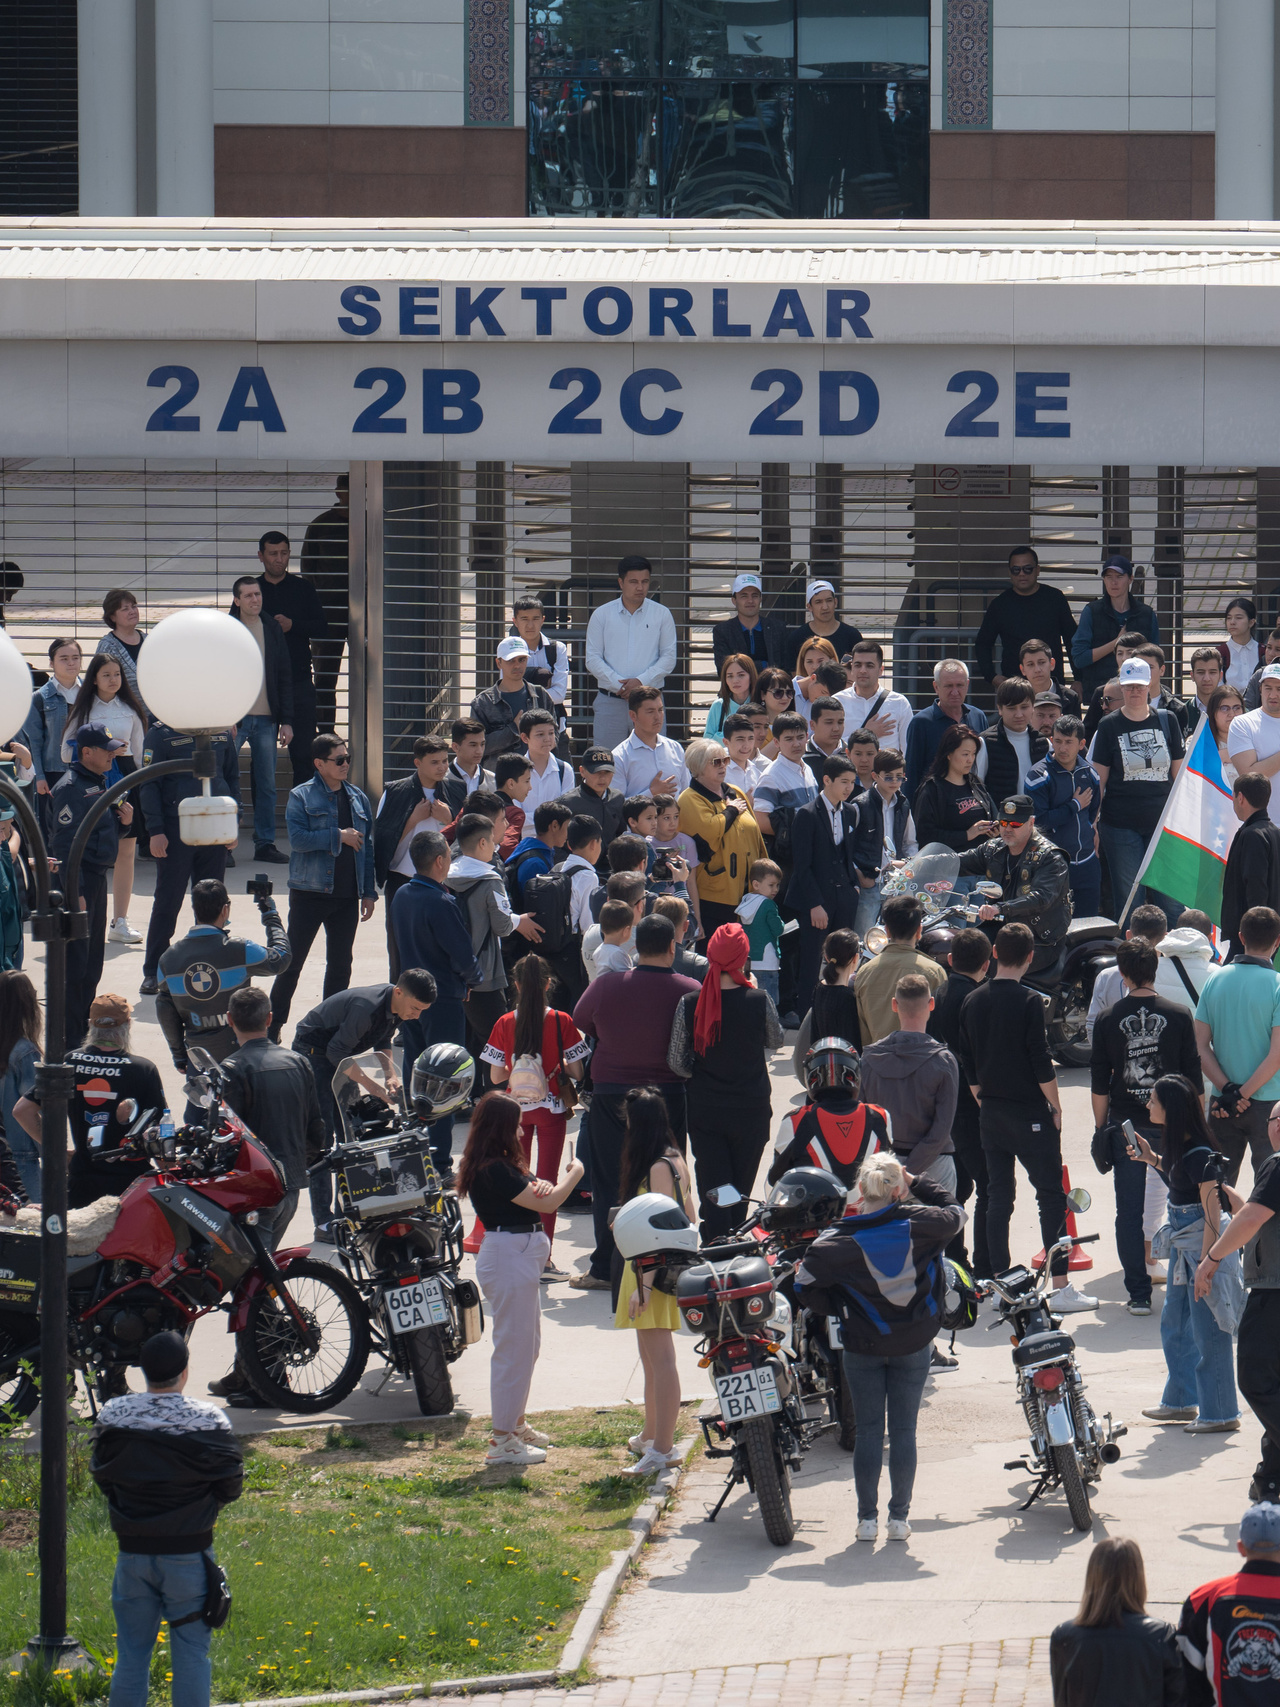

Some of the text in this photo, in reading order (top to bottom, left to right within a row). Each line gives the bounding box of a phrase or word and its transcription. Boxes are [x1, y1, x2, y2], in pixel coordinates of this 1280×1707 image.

[337, 284, 875, 339] SEKTORLAR
[145, 364, 1071, 438] 2A 2B 2C 2D 2E
[186, 964, 214, 977] BMW
[71, 1052, 132, 1065] HONDA
[1128, 1046, 1158, 1058] Supreme
[75, 1065, 121, 1077] REPSOL
[91, 1114, 108, 1122] GAS
[352, 1186, 370, 1196] let's
[180, 1197, 222, 1232] Kawasaki
[389, 1286, 440, 1311] 606 01
[396, 1307, 444, 1329] CA UZ
[1029, 1341, 1061, 1355] RealMoto
[718, 1373, 773, 1398] 221 01
[727, 1395, 778, 1418] BA UZ
